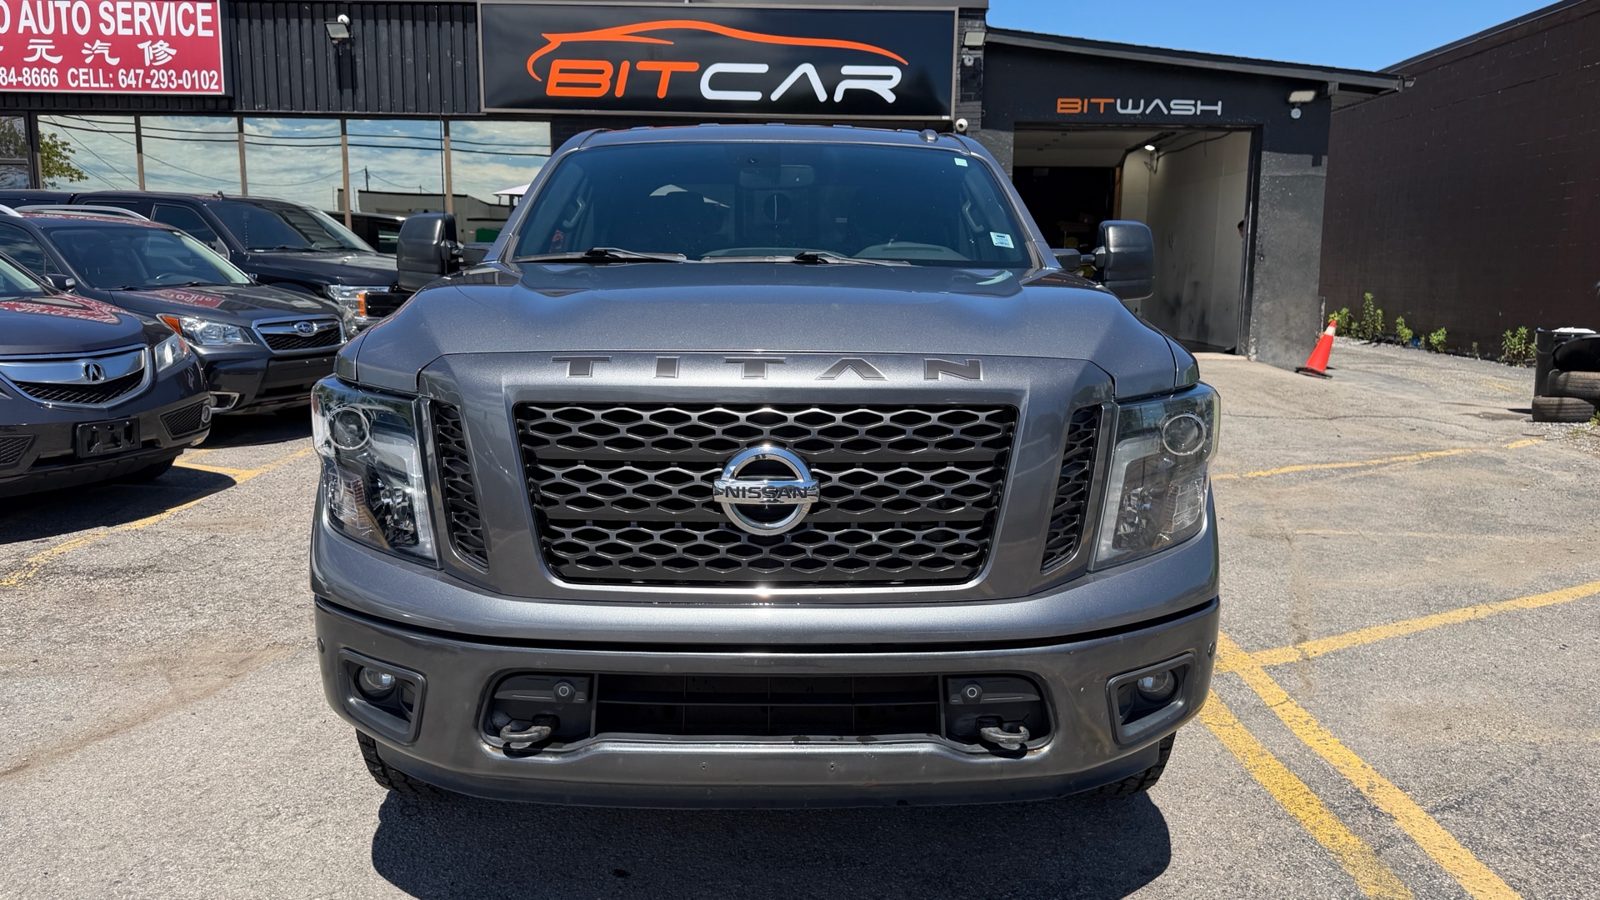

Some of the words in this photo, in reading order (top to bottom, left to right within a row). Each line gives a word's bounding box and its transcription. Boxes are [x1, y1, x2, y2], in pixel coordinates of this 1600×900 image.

[17, 1, 92, 36] AUTO
[98, 1, 214, 37] SERVICE
[0, 39, 177, 67] 元汽修
[67, 68, 114, 88] CELL:
[118, 69, 219, 90] 647-293-0102
[545, 59, 903, 104] BITCAR
[1056, 98, 1222, 116] BITWASH
[551, 355, 983, 382] TITAN
[725, 486, 808, 499] NISSAN
